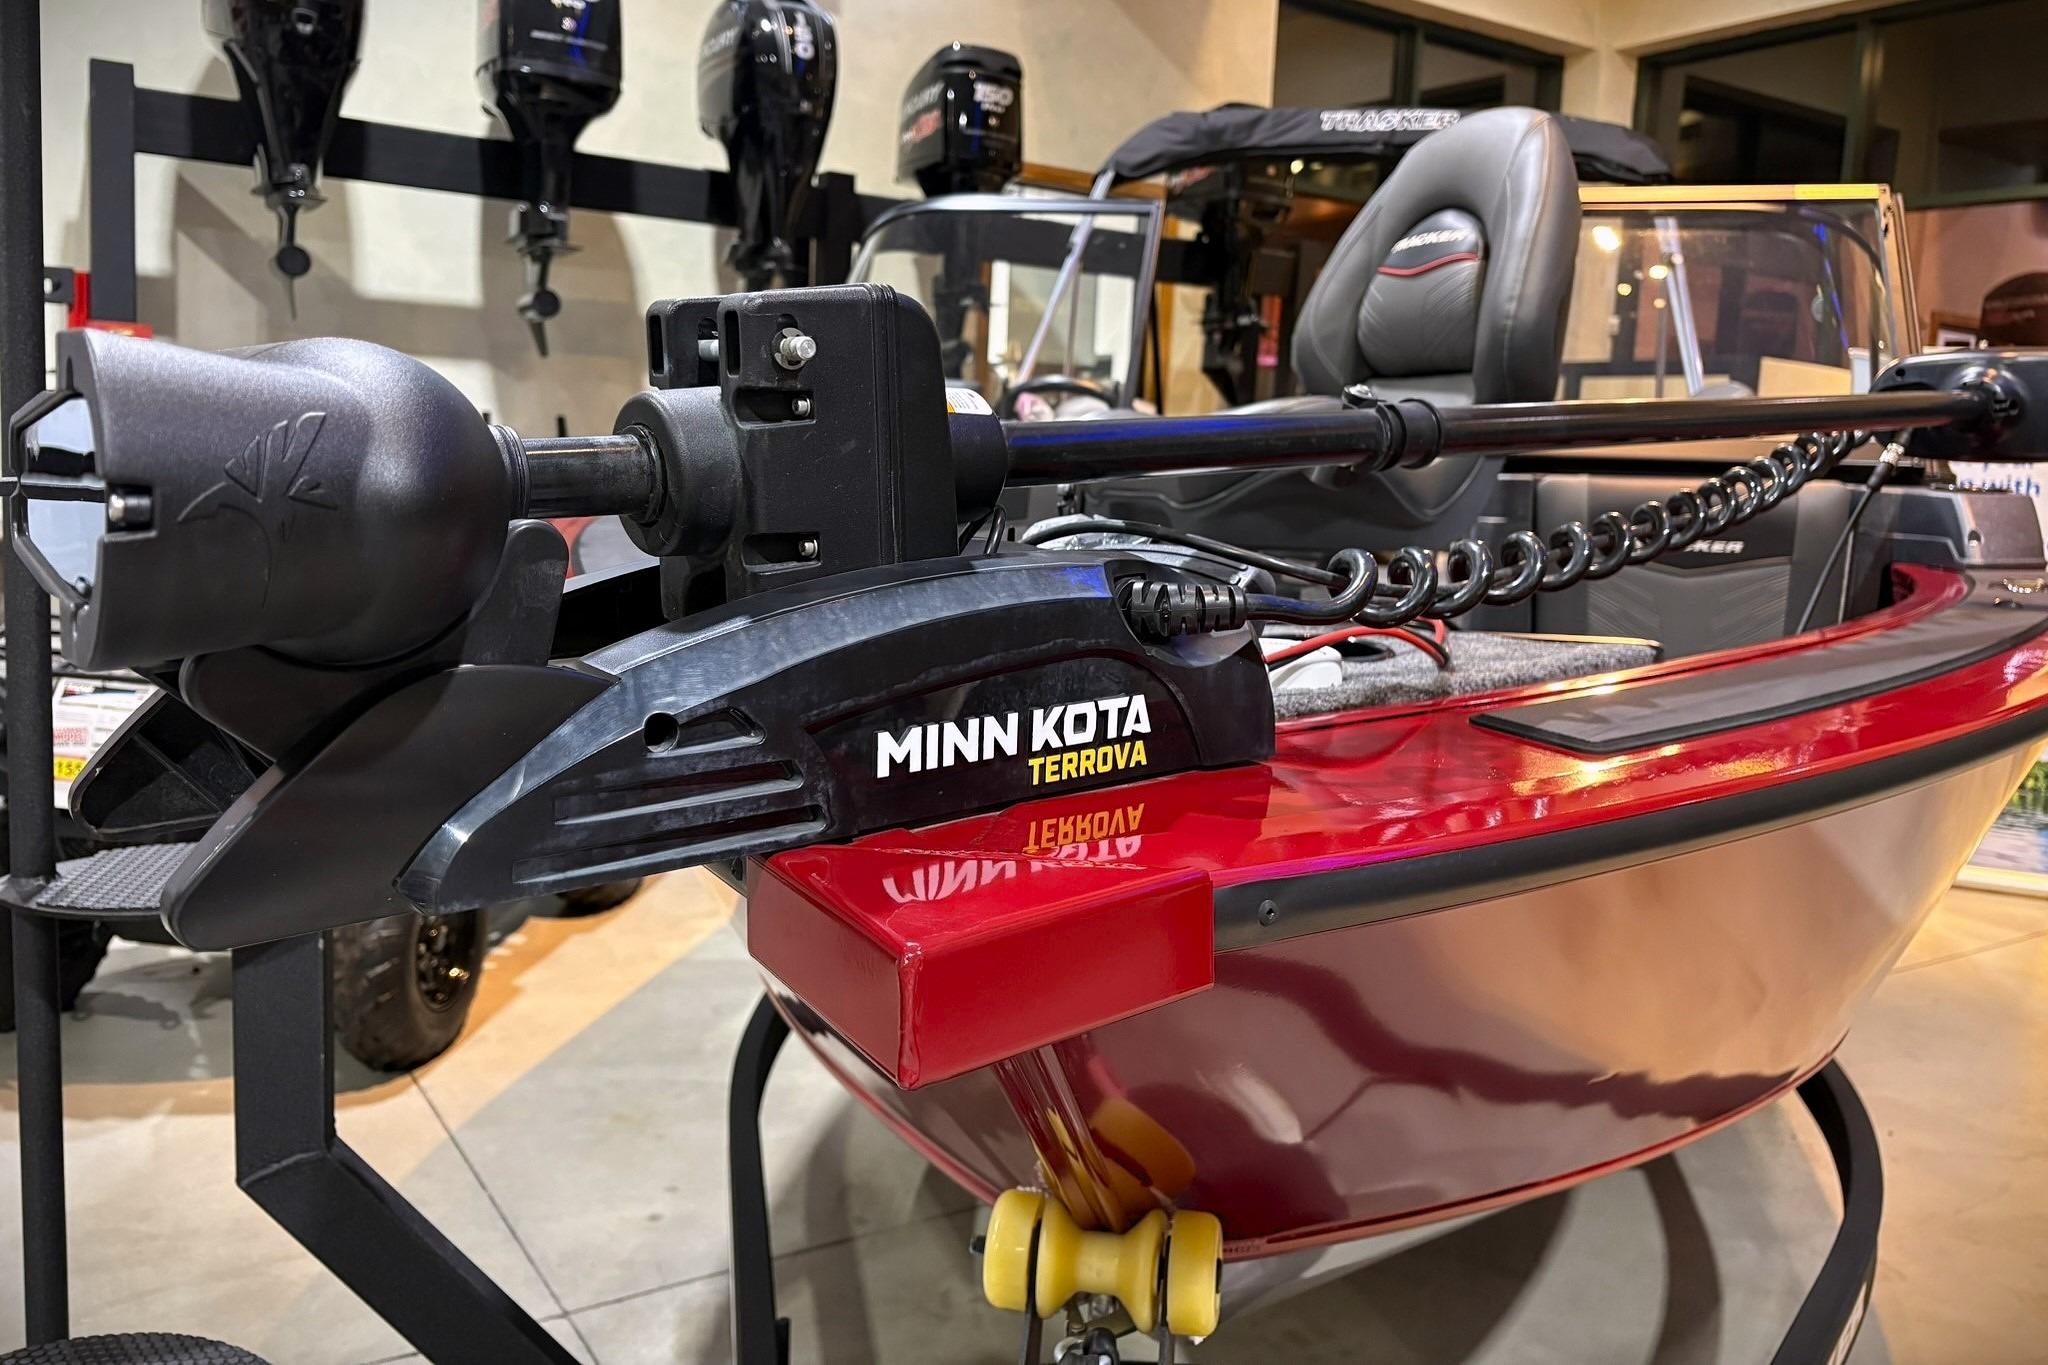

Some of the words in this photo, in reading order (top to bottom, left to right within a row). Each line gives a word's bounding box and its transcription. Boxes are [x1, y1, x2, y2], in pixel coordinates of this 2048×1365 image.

[1320, 108, 1461, 132] TRACKER
[876, 711, 1019, 779] MINN
[1031, 694, 1152, 752] KOTA
[1028, 740, 1148, 786] TERROVA
